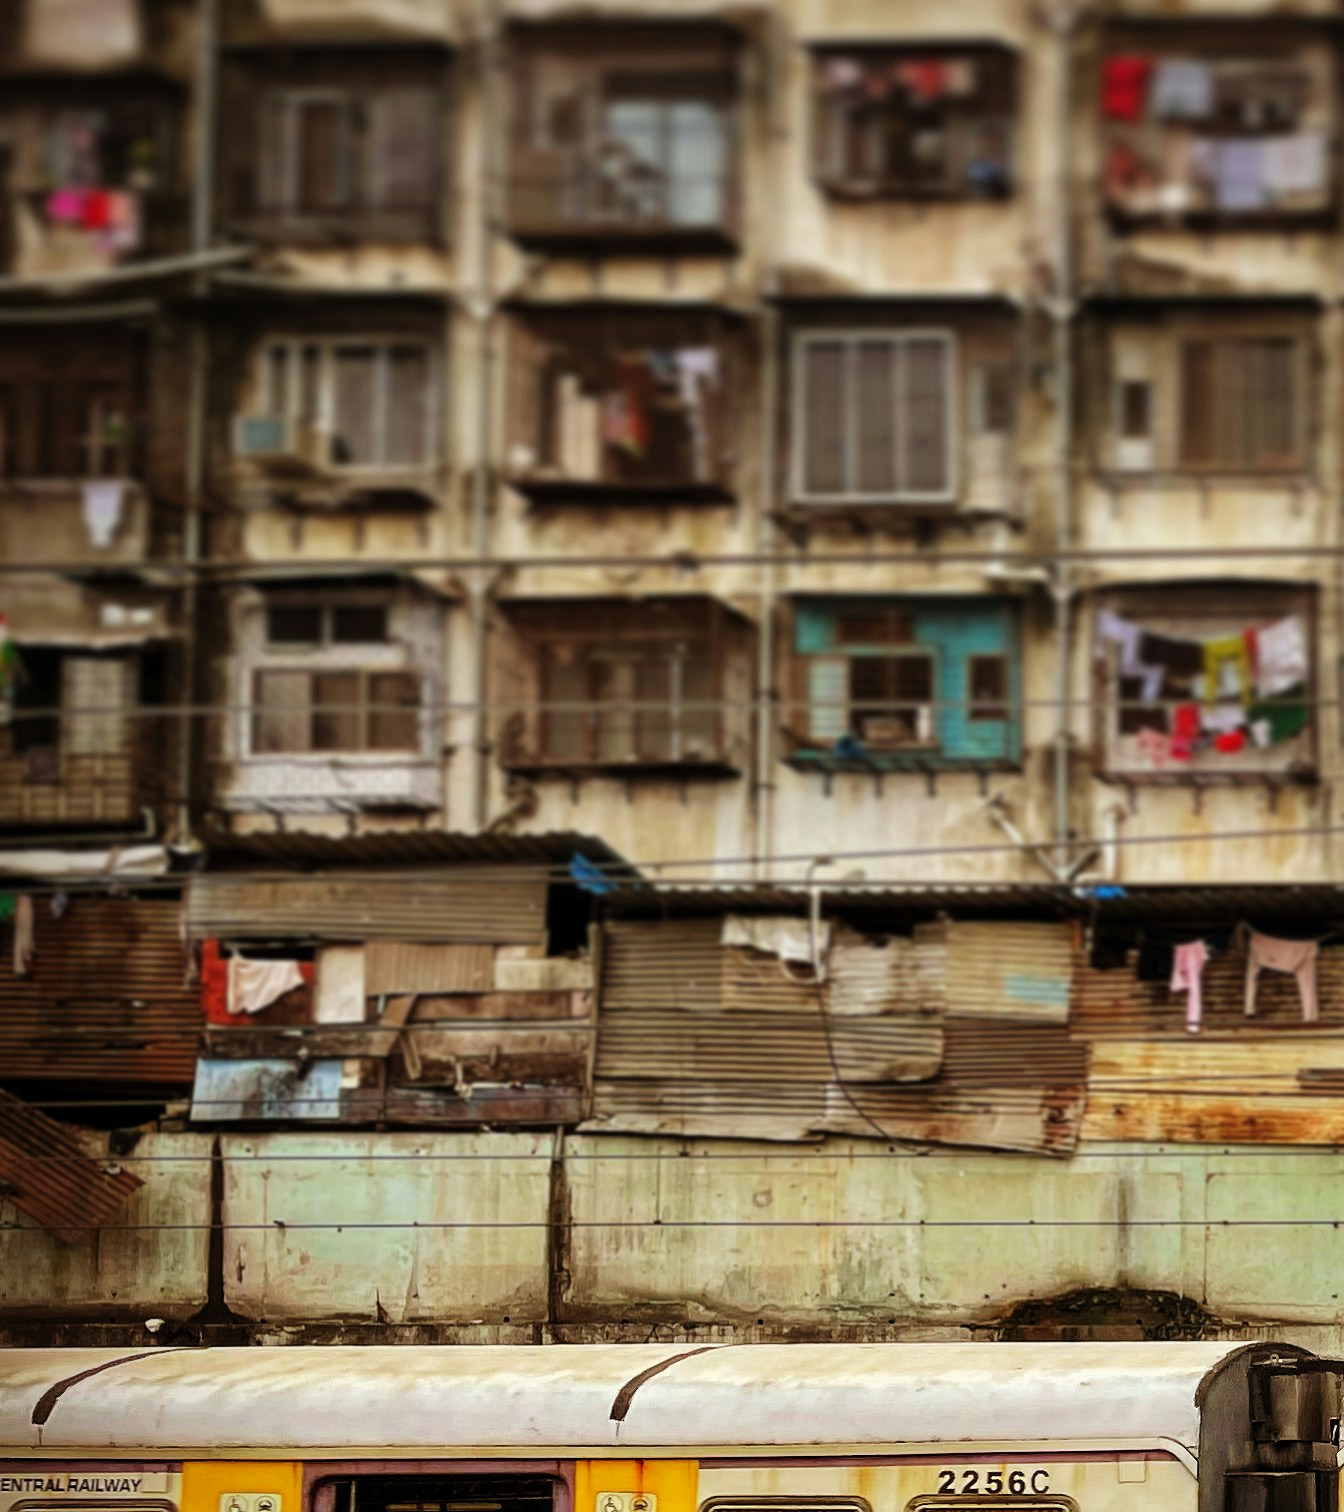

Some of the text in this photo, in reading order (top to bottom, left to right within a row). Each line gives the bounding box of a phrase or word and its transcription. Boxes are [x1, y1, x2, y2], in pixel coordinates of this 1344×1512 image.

[0, 1477, 142, 1493] ENTRAL RAILWAY
[937, 1469, 1050, 1495] 2256C
